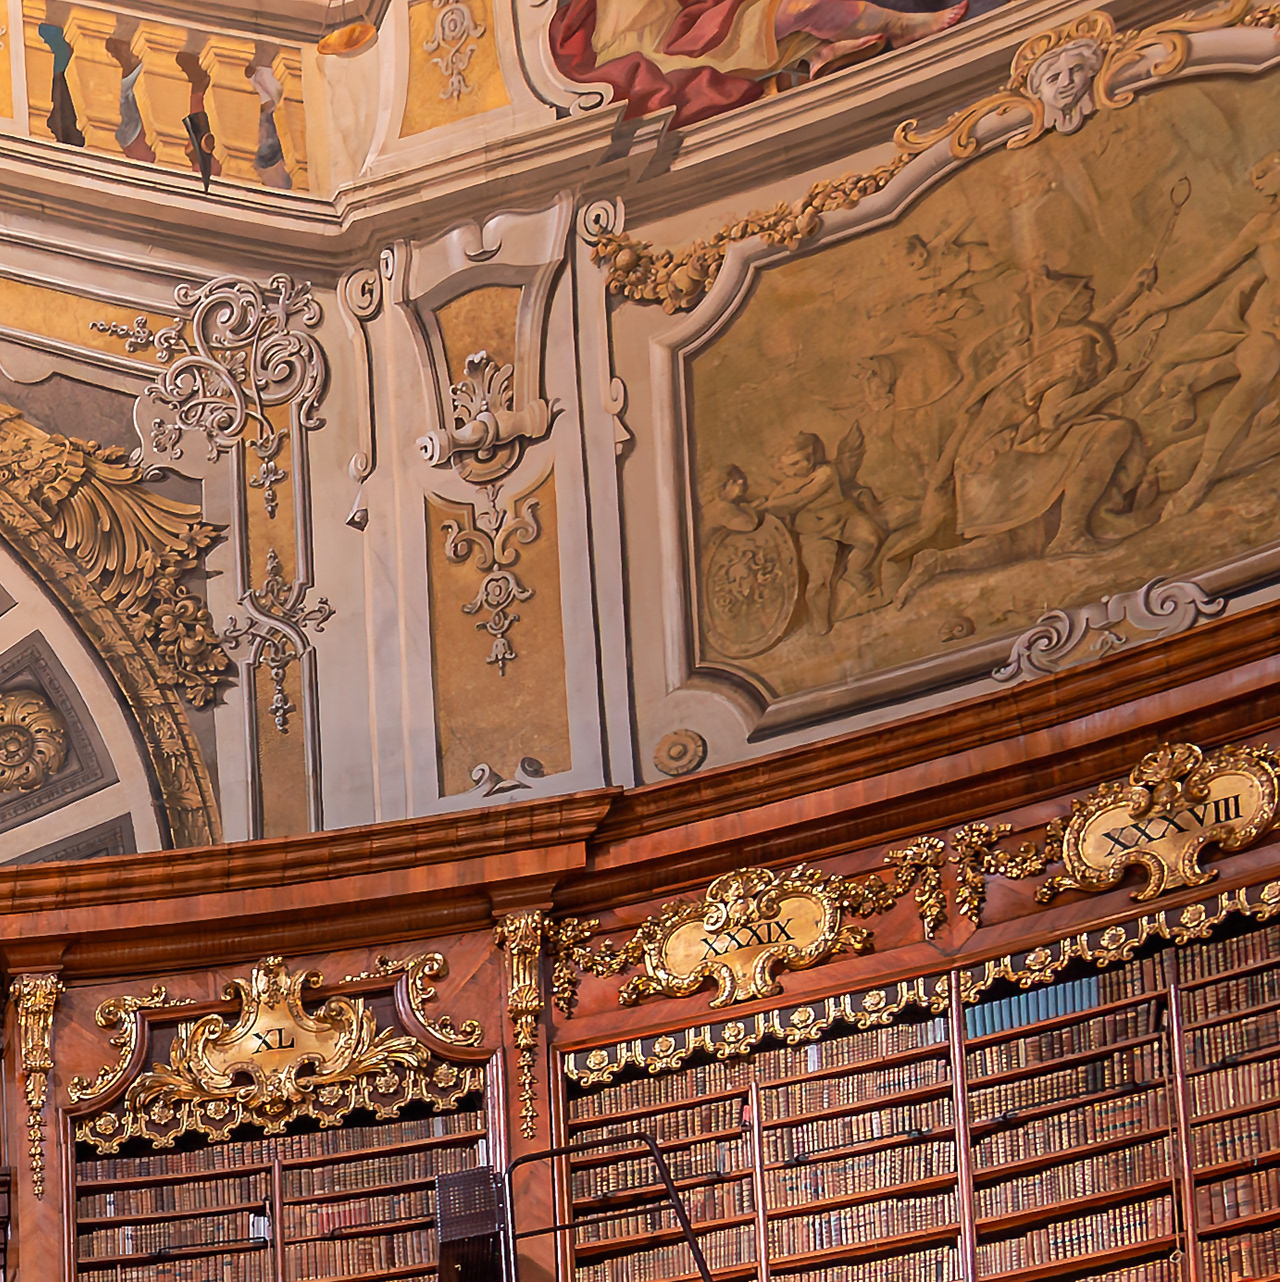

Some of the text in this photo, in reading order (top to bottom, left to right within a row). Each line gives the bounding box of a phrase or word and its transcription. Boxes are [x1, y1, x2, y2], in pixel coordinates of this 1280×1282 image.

[1101, 794, 1244, 858] XXXVIII
[700, 918, 795, 961] XXXIX
[251, 1027, 295, 1055] XL
